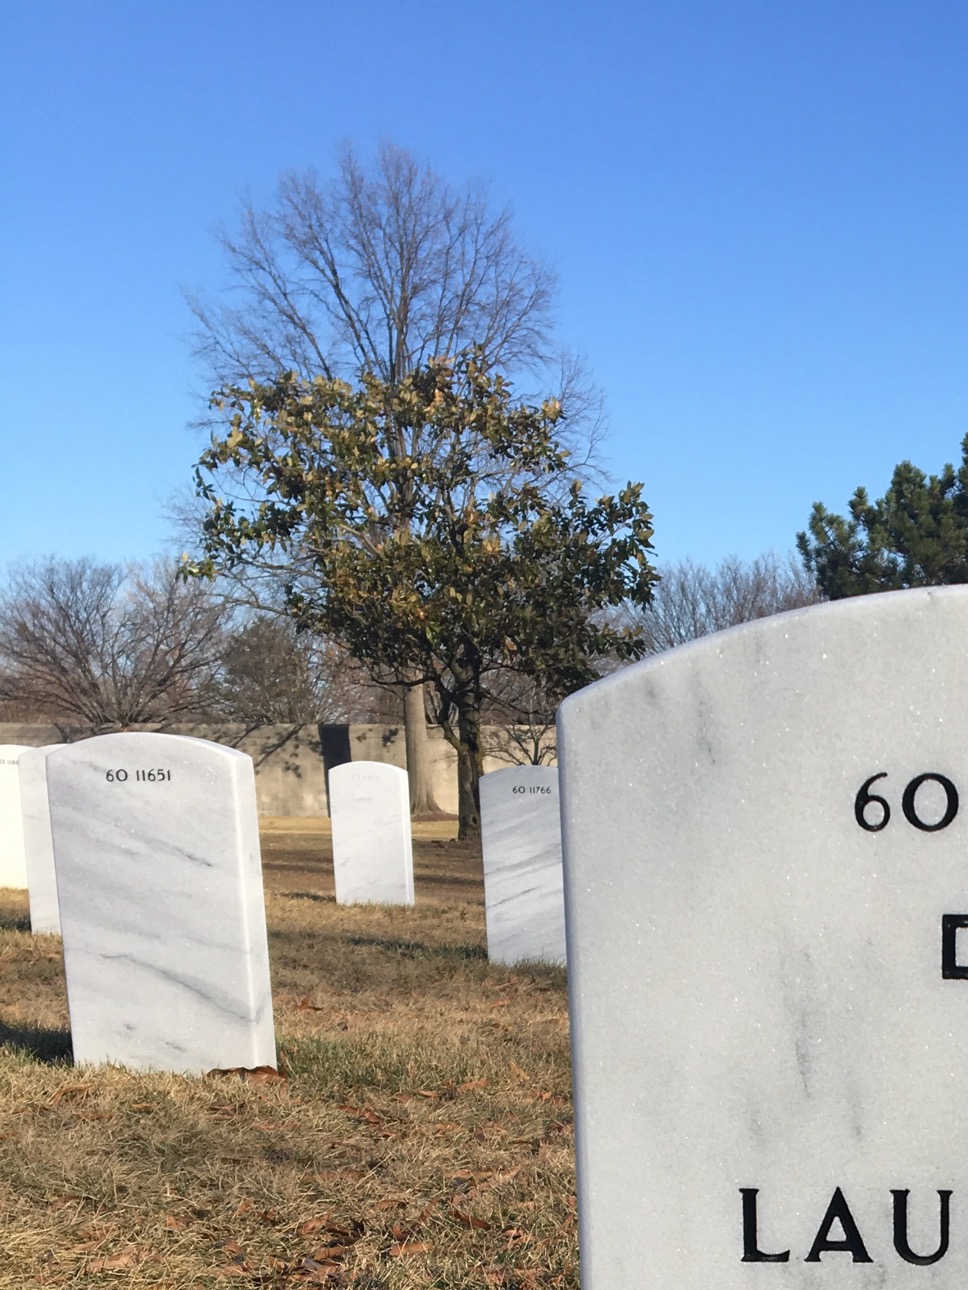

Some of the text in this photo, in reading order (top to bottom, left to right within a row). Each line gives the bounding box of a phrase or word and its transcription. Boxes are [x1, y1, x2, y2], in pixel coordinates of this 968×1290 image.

[106, 768, 171, 782] 60 11651
[512, 785, 552, 794] 60 11766
[854, 772, 960, 833] 60
